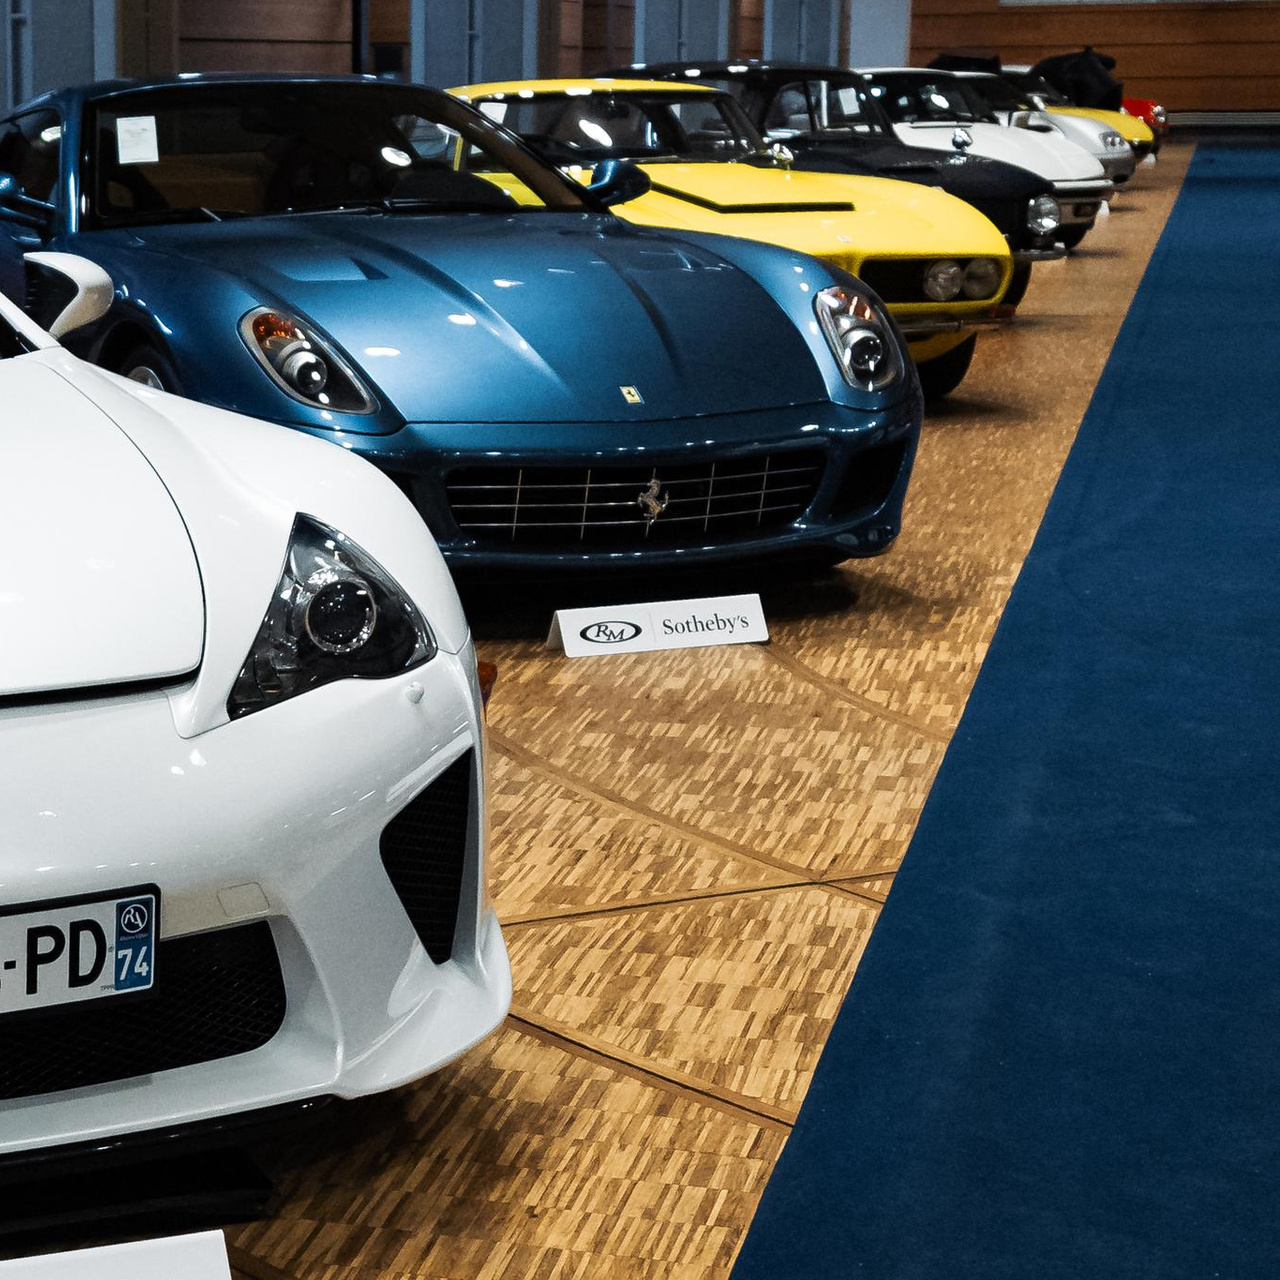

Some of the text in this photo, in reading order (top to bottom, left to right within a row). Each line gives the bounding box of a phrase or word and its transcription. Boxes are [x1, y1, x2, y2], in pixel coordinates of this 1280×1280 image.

[595, 613, 750, 641] RM Sotheby's
[117, 946, 150, 981] 74
